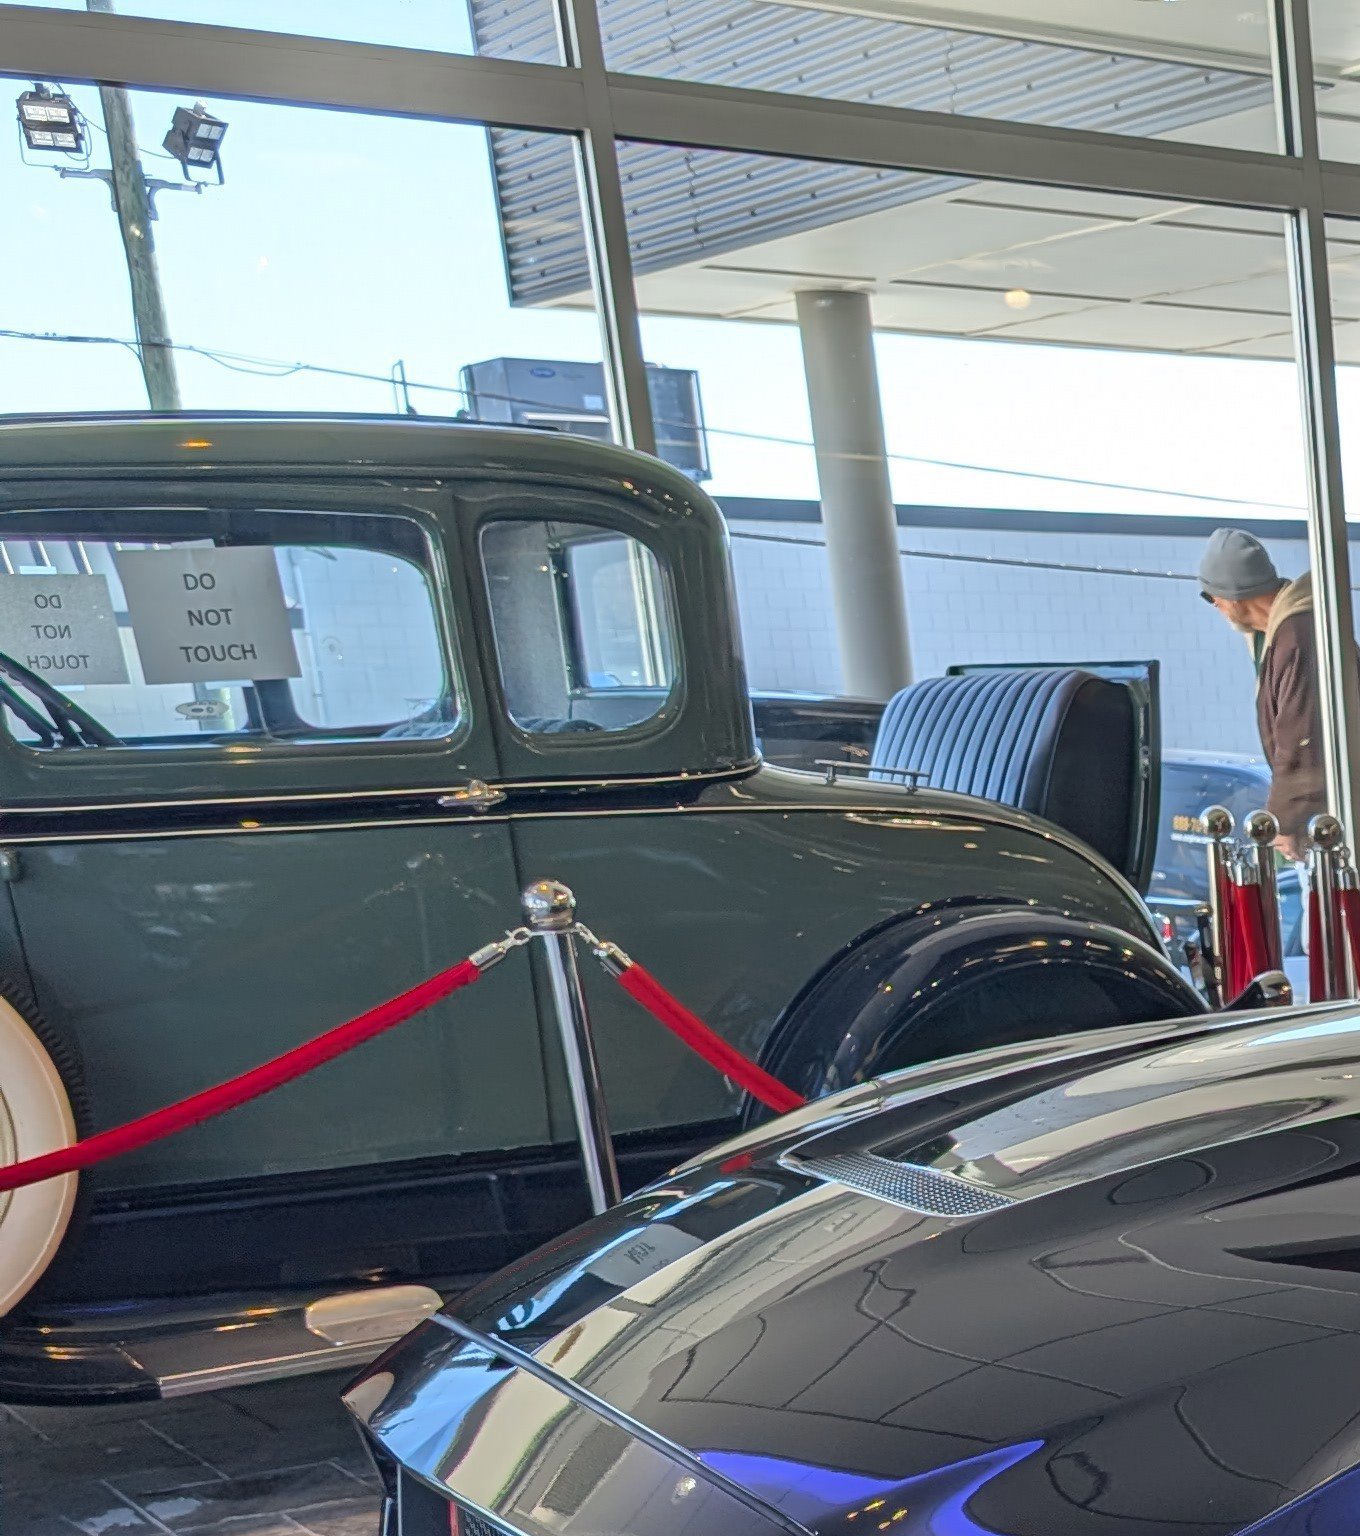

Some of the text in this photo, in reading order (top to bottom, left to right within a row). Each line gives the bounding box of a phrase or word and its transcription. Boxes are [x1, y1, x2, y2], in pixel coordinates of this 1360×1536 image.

[183, 572, 215, 590] DO
[188, 609, 233, 627] NOT
[180, 643, 258, 663] TOUCH
